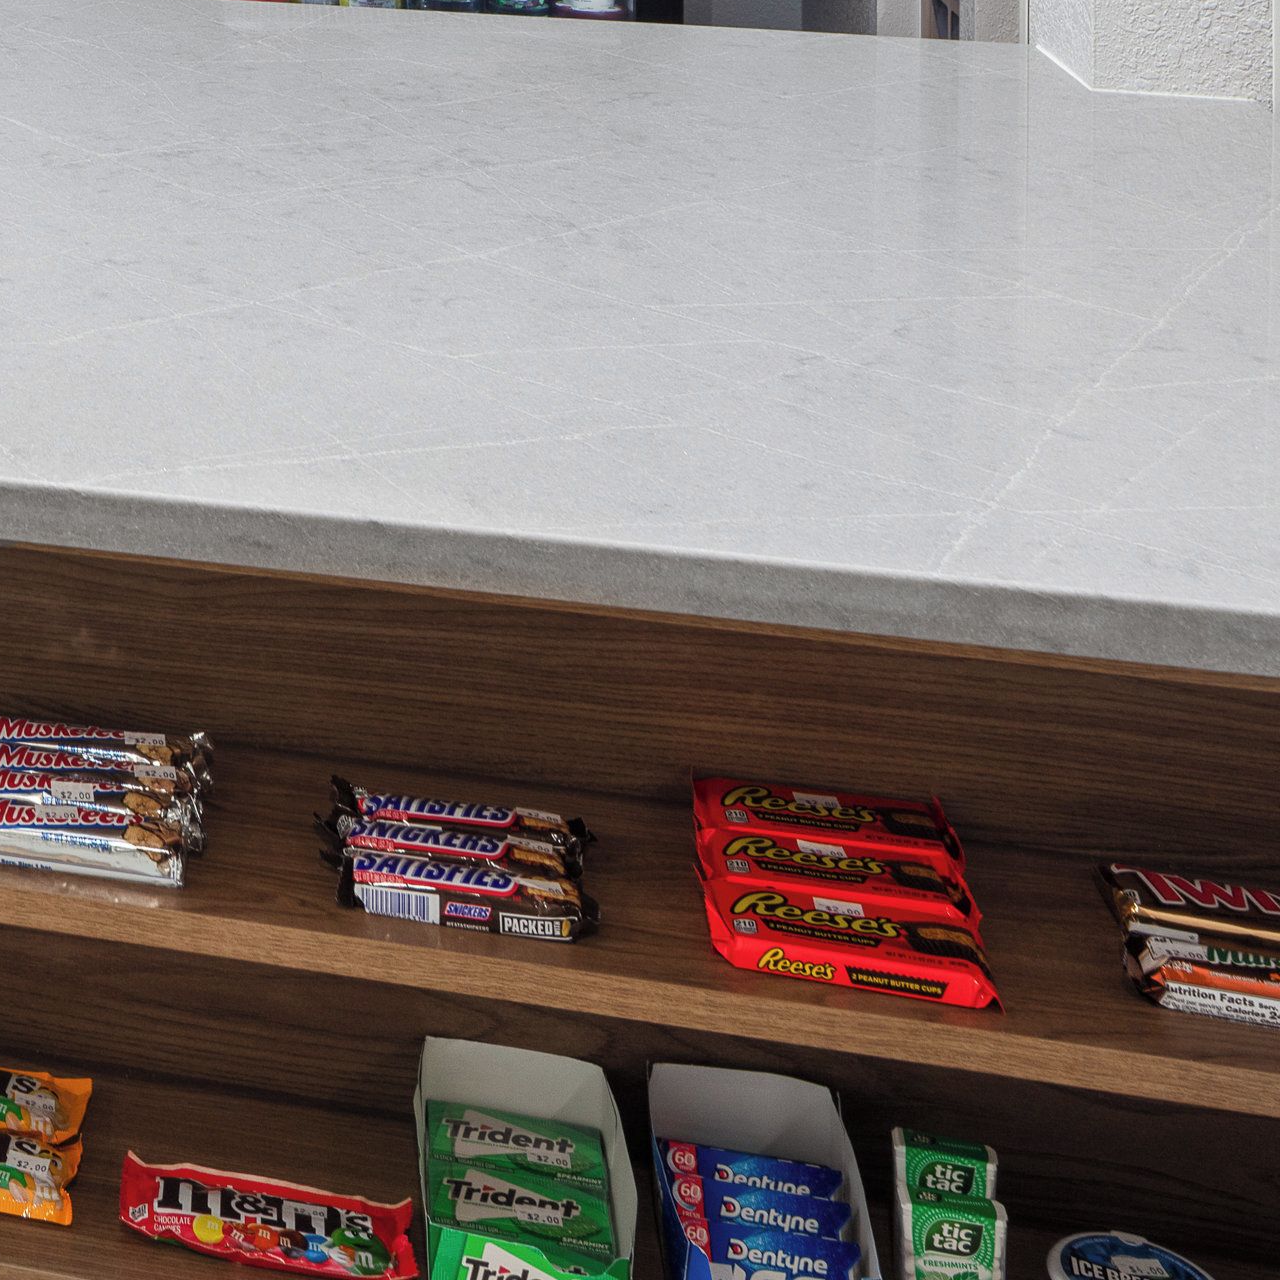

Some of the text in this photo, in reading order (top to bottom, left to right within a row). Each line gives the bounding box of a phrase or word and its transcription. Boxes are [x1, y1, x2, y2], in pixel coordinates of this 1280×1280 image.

[145, 770, 176, 780] $2.00
[60, 790, 92, 801] $2.00
[722, 786, 876, 822] Reese's
[44, 811, 77, 820] $2.00
[364, 795, 512, 822] SATISFIES
[800, 818, 857, 831] BUTTER CUPS
[724, 837, 886, 874] Reese's
[355, 852, 514, 889] SATISFIES
[1111, 863, 1280, 916] TWI
[446, 902, 490, 920] SNICKERS
[732, 892, 902, 938] Reese's
[826, 905, 862, 916] $2.00
[503, 917, 554, 936] PACKED
[776, 924, 877, 946] PEANUT BUTTER CUPS
[758, 947, 836, 981] Reese's
[852, 972, 943, 994] 2 PEANUT BUTTER CUPS
[1220, 993, 1255, 1008] Facts
[1225, 1005, 1266, 1019] Calories
[443, 1118, 575, 1154] Trident
[15, 1159, 48, 1173] $2.00
[536, 1153, 569, 1167] $2.00
[673, 1151, 695, 1167] 60
[556, 1172, 603, 1186] SPEARMINT
[715, 1163, 811, 1196] Dentyne
[934, 1162, 966, 1181] tic
[680, 1183, 702, 1199] 60
[926, 1176, 964, 1194] tac
[445, 1178, 580, 1219] Trident
[153, 1214, 192, 1226] CHOCOLATE
[526, 1213, 561, 1225] $2.00
[720, 1195, 820, 1234] Dentyne
[941, 1221, 973, 1240] tic
[561, 1236, 610, 1250] SPEARMINT
[931, 1234, 971, 1254] tac
[727, 1238, 828, 1275] Dentyne
[921, 1258, 979, 1272] FRESHMINTS
[1069, 1255, 1104, 1277] ICE
